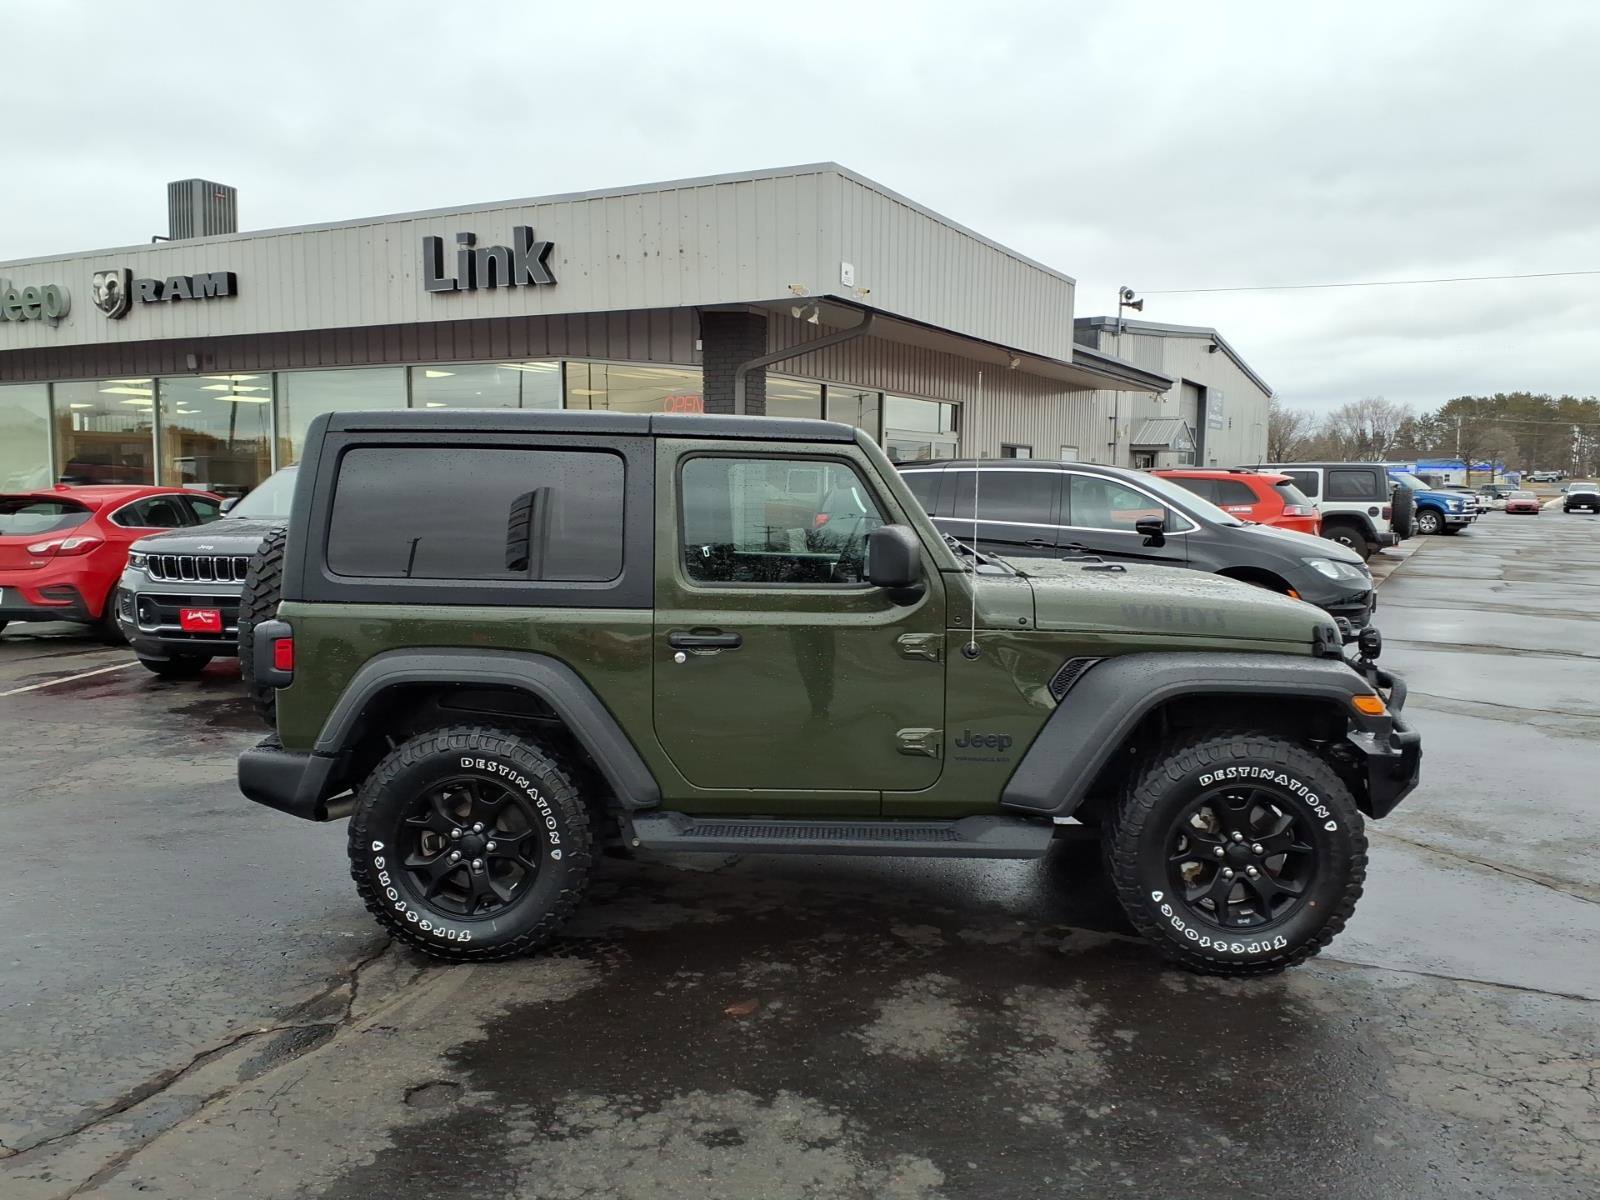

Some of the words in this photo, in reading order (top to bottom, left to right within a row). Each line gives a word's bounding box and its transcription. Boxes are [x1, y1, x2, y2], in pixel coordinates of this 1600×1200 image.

[422, 225, 557, 293] Link
[132, 271, 238, 303] RAM
[664, 395, 704, 414] OPEN
[954, 729, 1013, 752] Jeep
[460, 757, 561, 845] DESTINATION
[1199, 766, 1331, 819] DESTINATION
